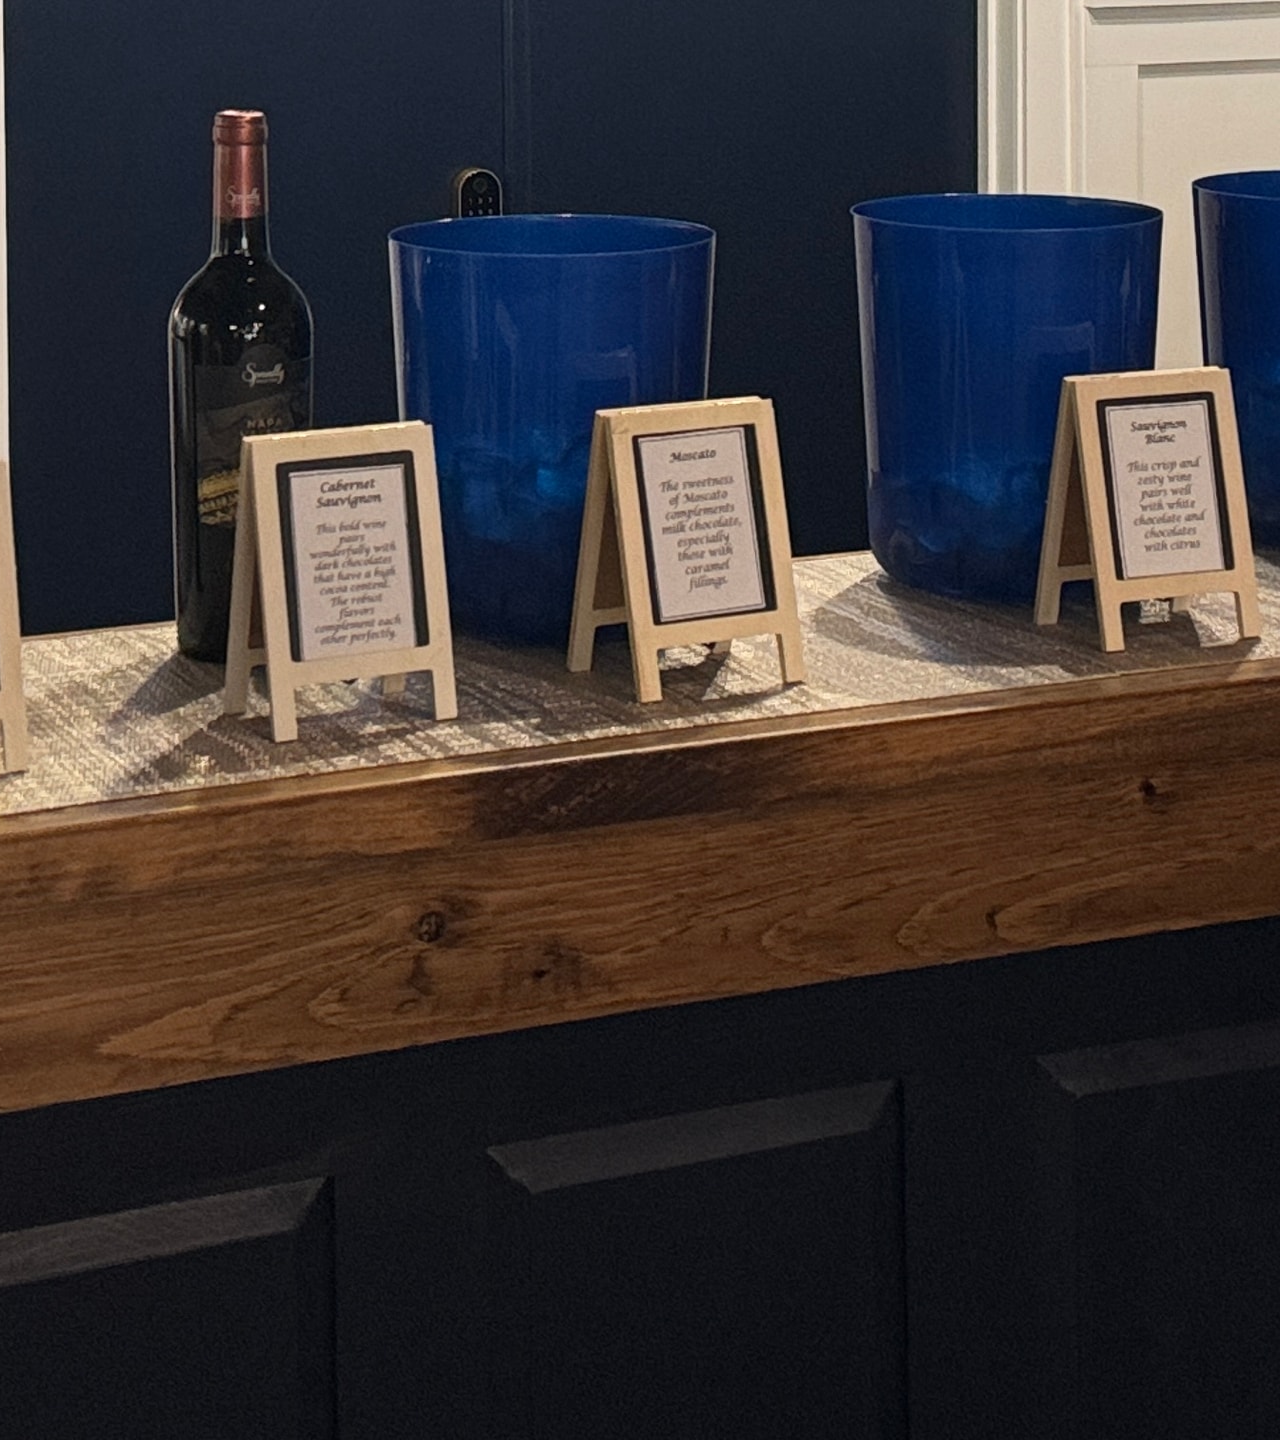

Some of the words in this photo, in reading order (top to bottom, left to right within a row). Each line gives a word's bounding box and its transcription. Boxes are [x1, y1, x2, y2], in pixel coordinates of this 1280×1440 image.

[1131, 419, 1187, 433] Sauvignon
[1145, 433, 1175, 444] Blanc
[669, 449, 716, 463] Moscato
[1127, 460, 1148, 473] This
[1151, 460, 1177, 472] crisp
[1179, 456, 1202, 468] and
[320, 478, 375, 493] Cabernet
[659, 479, 678, 493] The
[682, 475, 734, 490] sweetness
[1137, 474, 1164, 486] zesty
[1167, 473, 1192, 482] wine
[669, 493, 680, 506] of
[684, 490, 728, 504] Moscato
[1141, 488, 1167, 501] pairs
[1171, 484, 1192, 495] well
[316, 493, 382, 509] Sauvignon
[1140, 500, 1164, 511] with
[1167, 498, 1195, 509] white
[665, 503, 735, 521] complements
[1133, 512, 1181, 526] chocolate
[1185, 509, 1207, 521] and
[661, 520, 686, 535] milk
[1144, 524, 1197, 539] chocolates
[677, 532, 730, 551] especially
[1144, 540, 1168, 553] with
[1170, 539, 1200, 550] citrus
[678, 547, 705, 561] those
[709, 543, 734, 556] with
[684, 560, 730, 575] caramel
